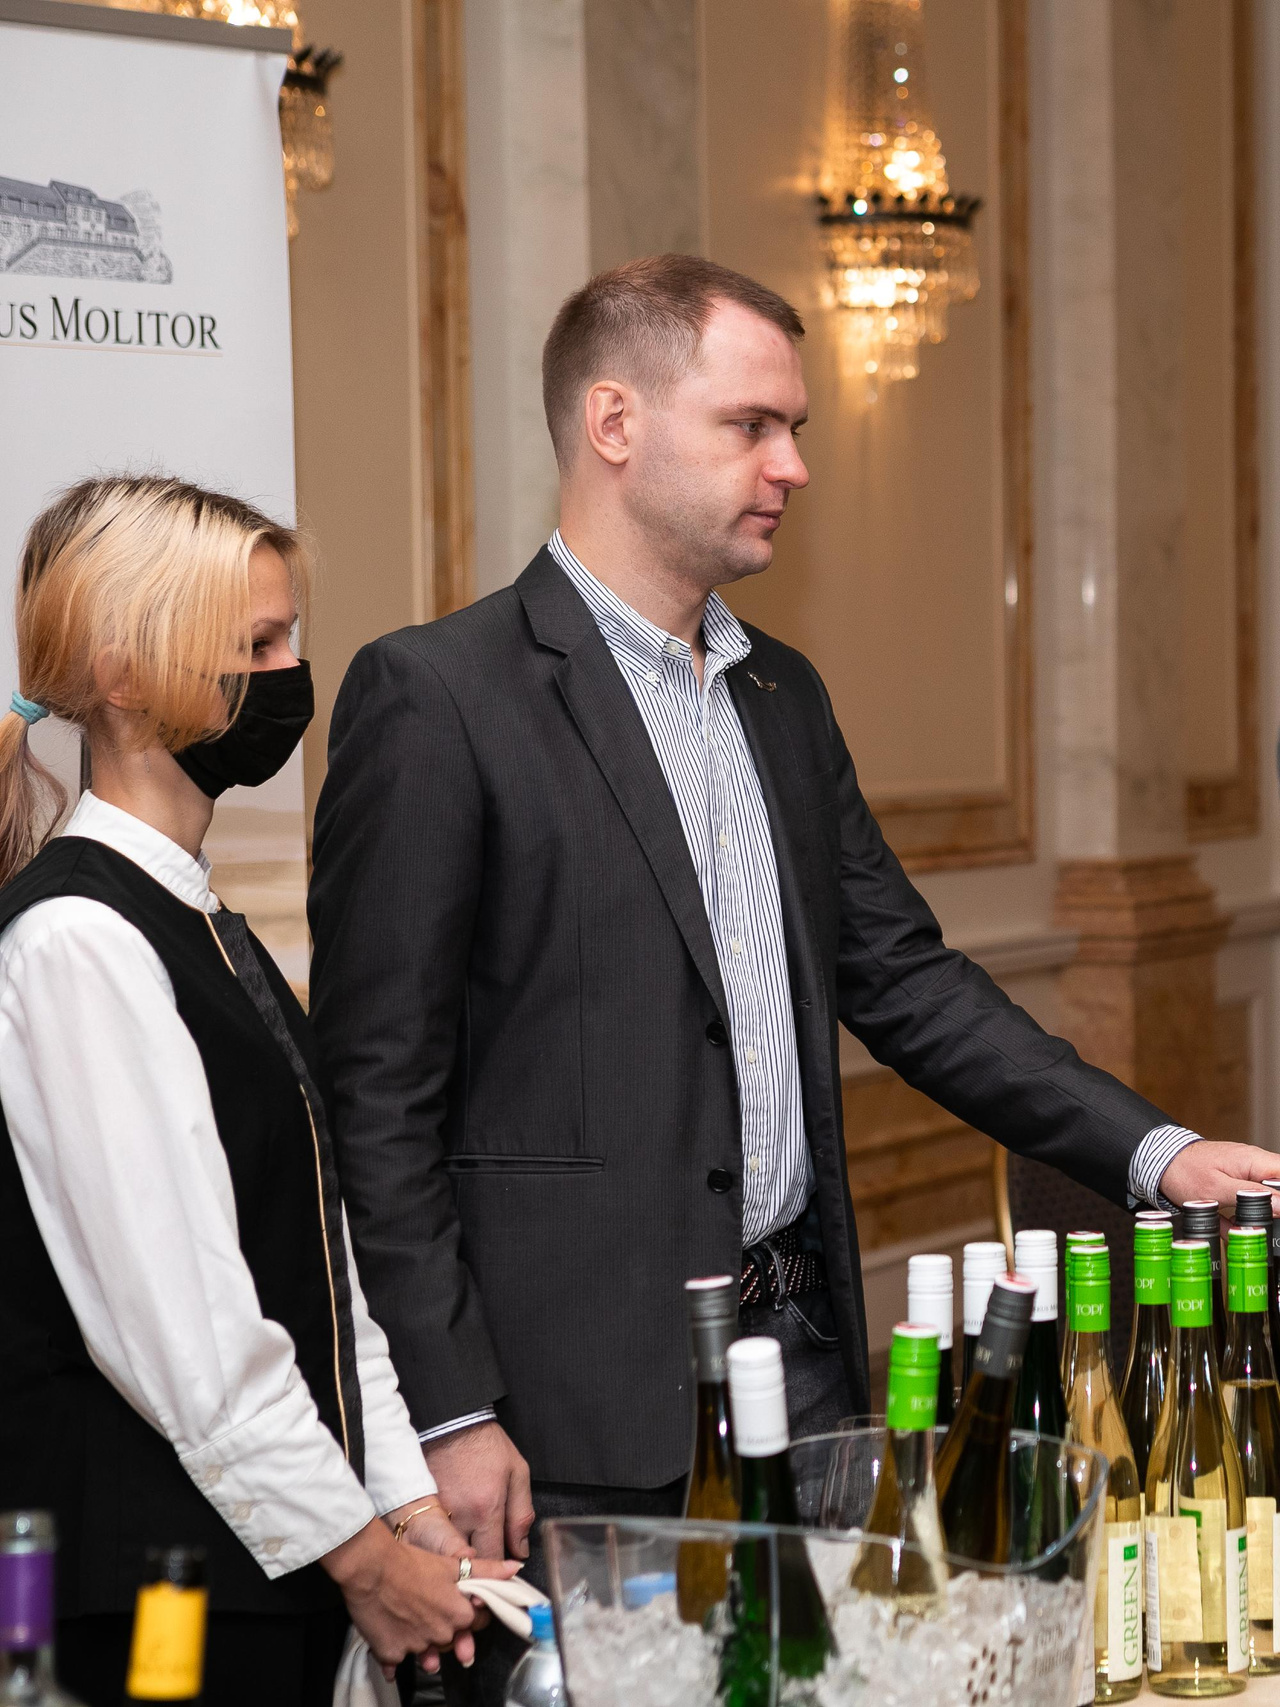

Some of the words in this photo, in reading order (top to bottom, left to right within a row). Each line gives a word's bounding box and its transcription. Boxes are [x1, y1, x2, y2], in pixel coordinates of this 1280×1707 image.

[50, 294, 222, 350] MOLITOR
[1211, 1260, 1221, 1271] TO
[1247, 1284, 1268, 1297] TOP
[1076, 1303, 1104, 1316] TOPF
[1176, 1299, 1204, 1312] TOPF
[1238, 1556, 1248, 1657] GREEN
[1123, 1564, 1138, 1667] GREEN
